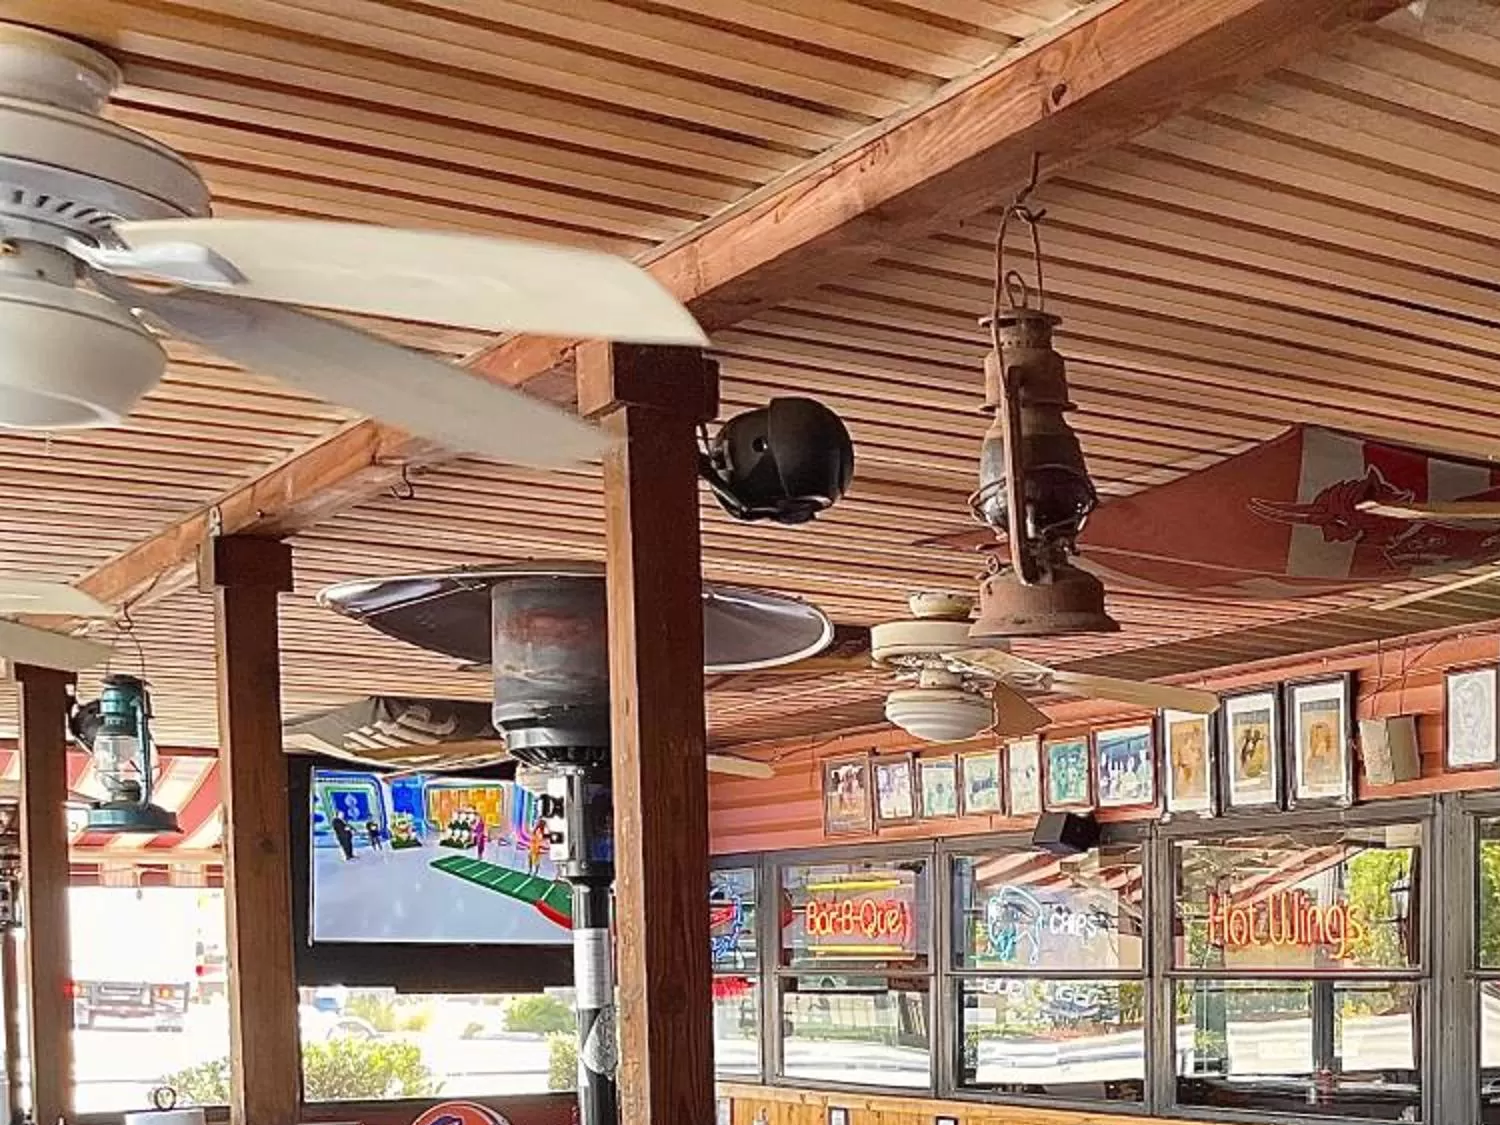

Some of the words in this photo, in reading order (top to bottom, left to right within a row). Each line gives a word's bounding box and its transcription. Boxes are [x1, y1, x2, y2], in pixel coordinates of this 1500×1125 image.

[806, 899, 902, 938] Bar-B-Que
[1209, 893, 1261, 946] Hot
[1269, 890, 1366, 960] Wings
